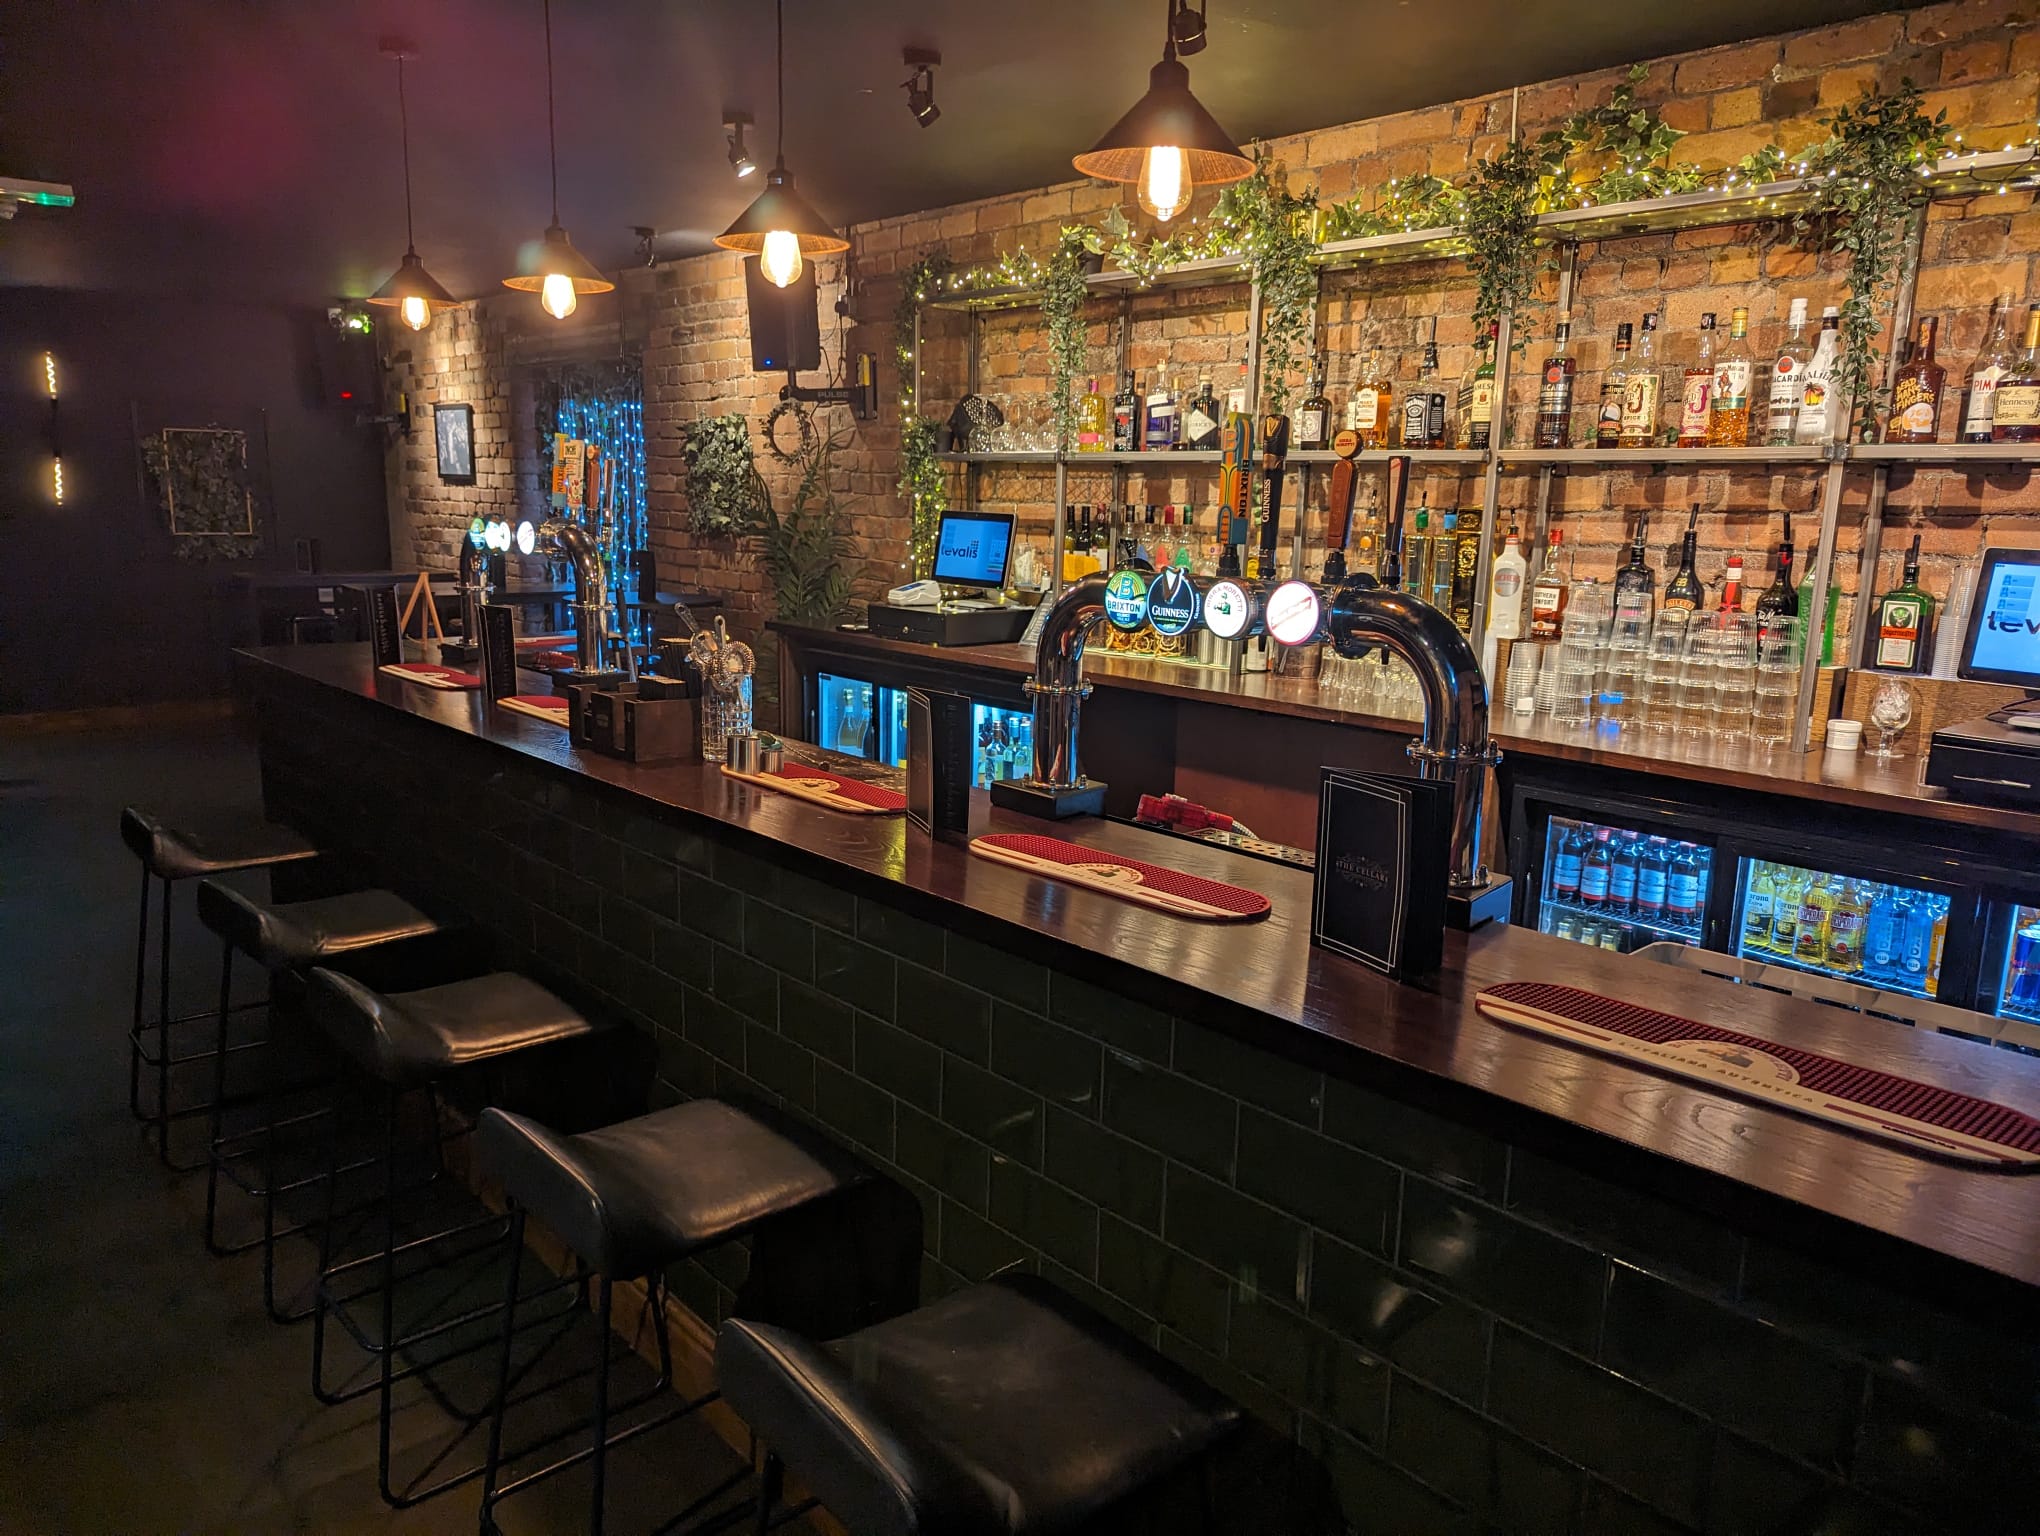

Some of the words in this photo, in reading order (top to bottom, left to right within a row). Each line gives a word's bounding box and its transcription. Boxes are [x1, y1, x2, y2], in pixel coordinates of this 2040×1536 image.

[1239, 459, 1249, 517] BRIXTON
[1262, 478, 1272, 523] GUINNESS
[1107, 600, 1141, 613] BRIXTON
[1151, 605, 1190, 619] GUINNESS
